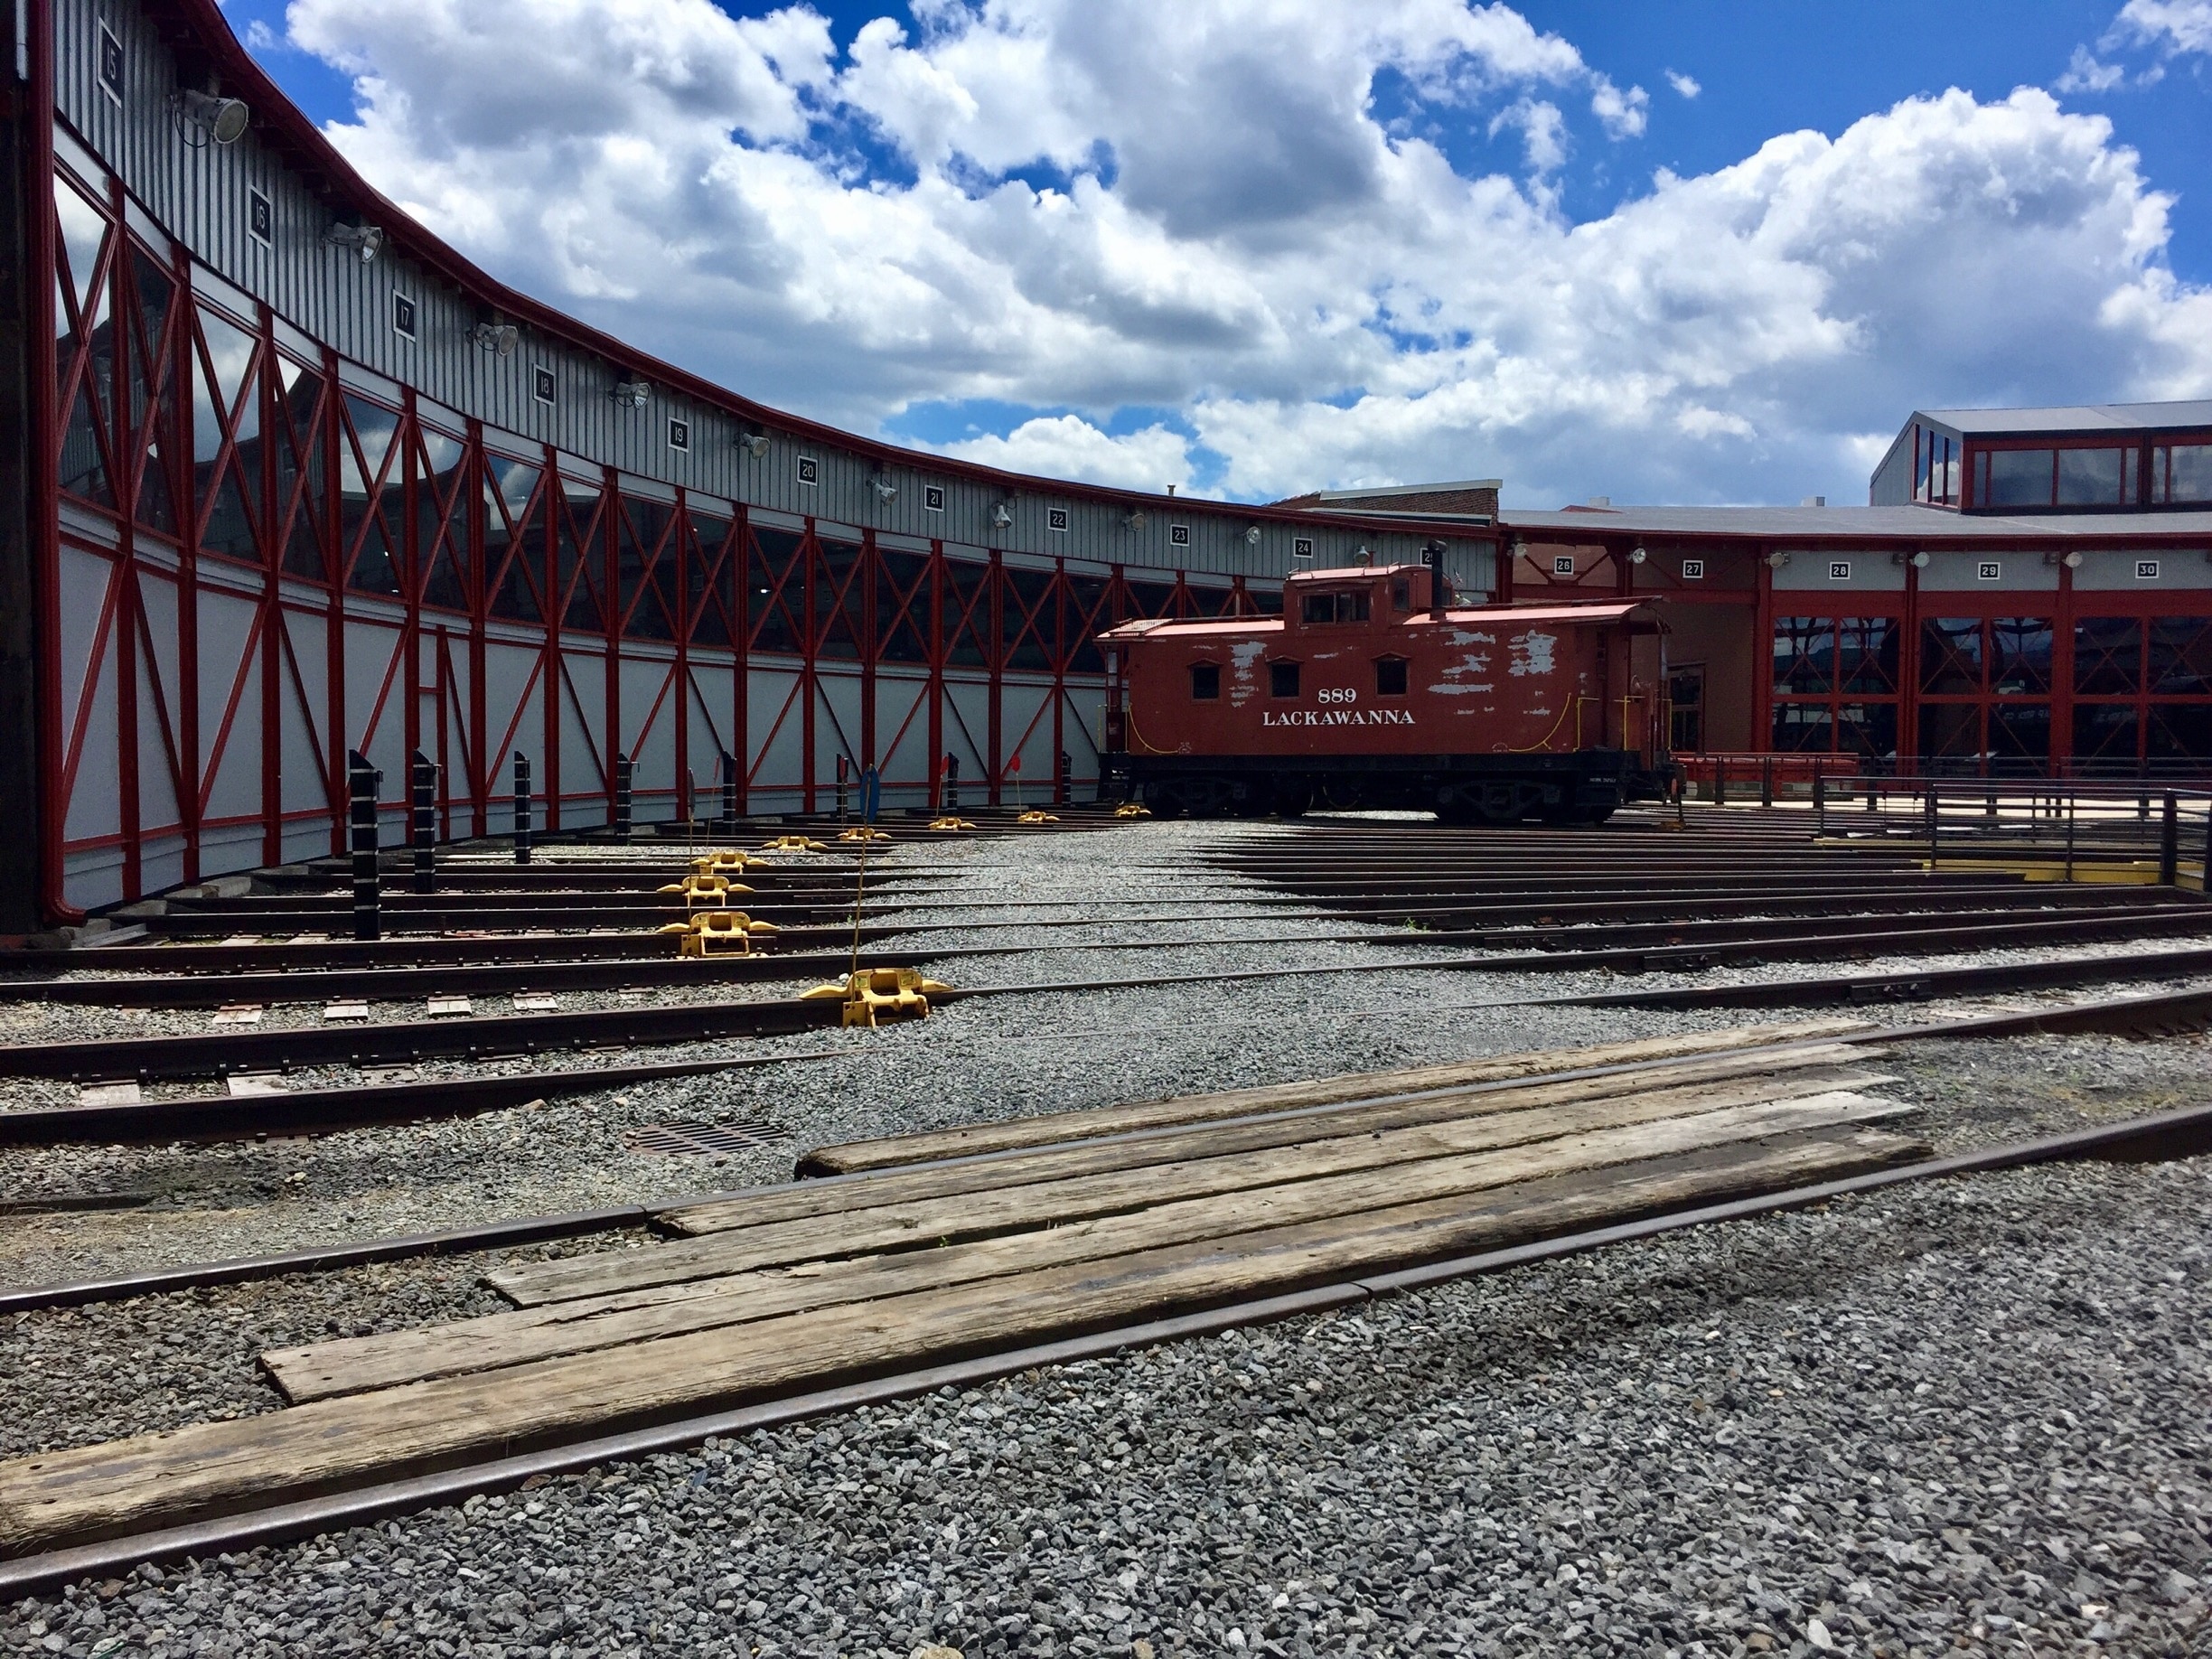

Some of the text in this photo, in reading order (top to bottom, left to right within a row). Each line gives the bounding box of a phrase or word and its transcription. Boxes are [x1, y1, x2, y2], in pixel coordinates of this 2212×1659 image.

[107, 47, 117, 80] 15
[256, 204, 266, 230] 16
[400, 305, 410, 326] 17
[540, 376, 549, 395] 18
[675, 426, 684, 443] 19
[801, 463, 814, 478] 20
[931, 492, 939, 505] 21
[1052, 513, 1064, 526] 22
[1174, 530, 1186, 541] 23
[1298, 542, 1309, 553] 24
[1557, 560, 1570, 570] 26
[1686, 564, 1700, 575] 27
[1832, 566, 1847, 576] 28
[1982, 566, 1997, 576] 29
[2140, 565, 2155, 575] 30
[1317, 689, 1357, 704] 889
[1262, 709, 1416, 726] LACKAWANNA
